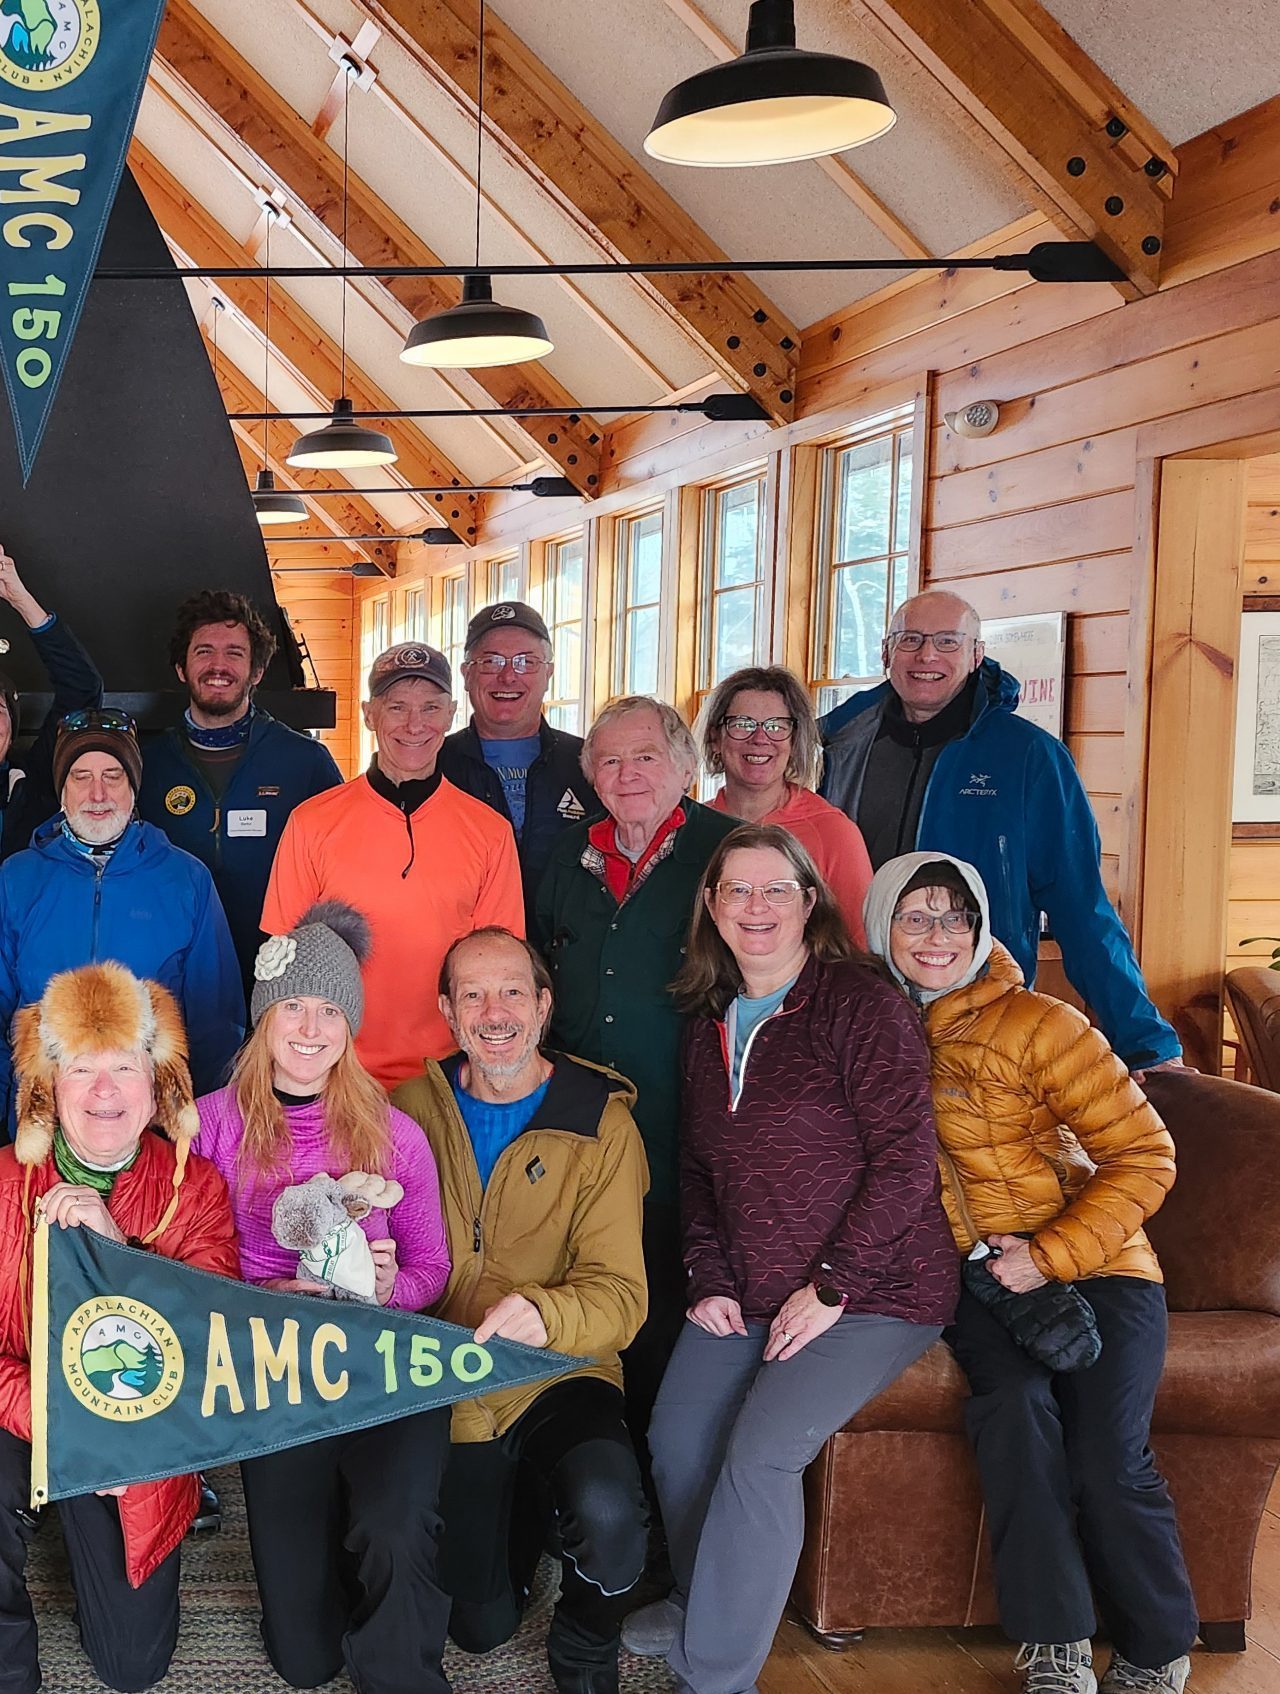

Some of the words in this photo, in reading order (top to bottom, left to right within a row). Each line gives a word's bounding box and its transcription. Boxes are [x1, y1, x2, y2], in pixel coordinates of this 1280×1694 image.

[58, 1, 72, 50] AMC
[7, 273, 67, 389] 150
[71, 1301, 174, 1348] APPALACHIAN
[98, 1323, 142, 1340] AMC
[68, 1362, 144, 1416] MOUNTAIN
[152, 1370, 178, 1406] CLUB
[200, 1311, 349, 1418] AMC
[373, 1329, 494, 1395] 150
